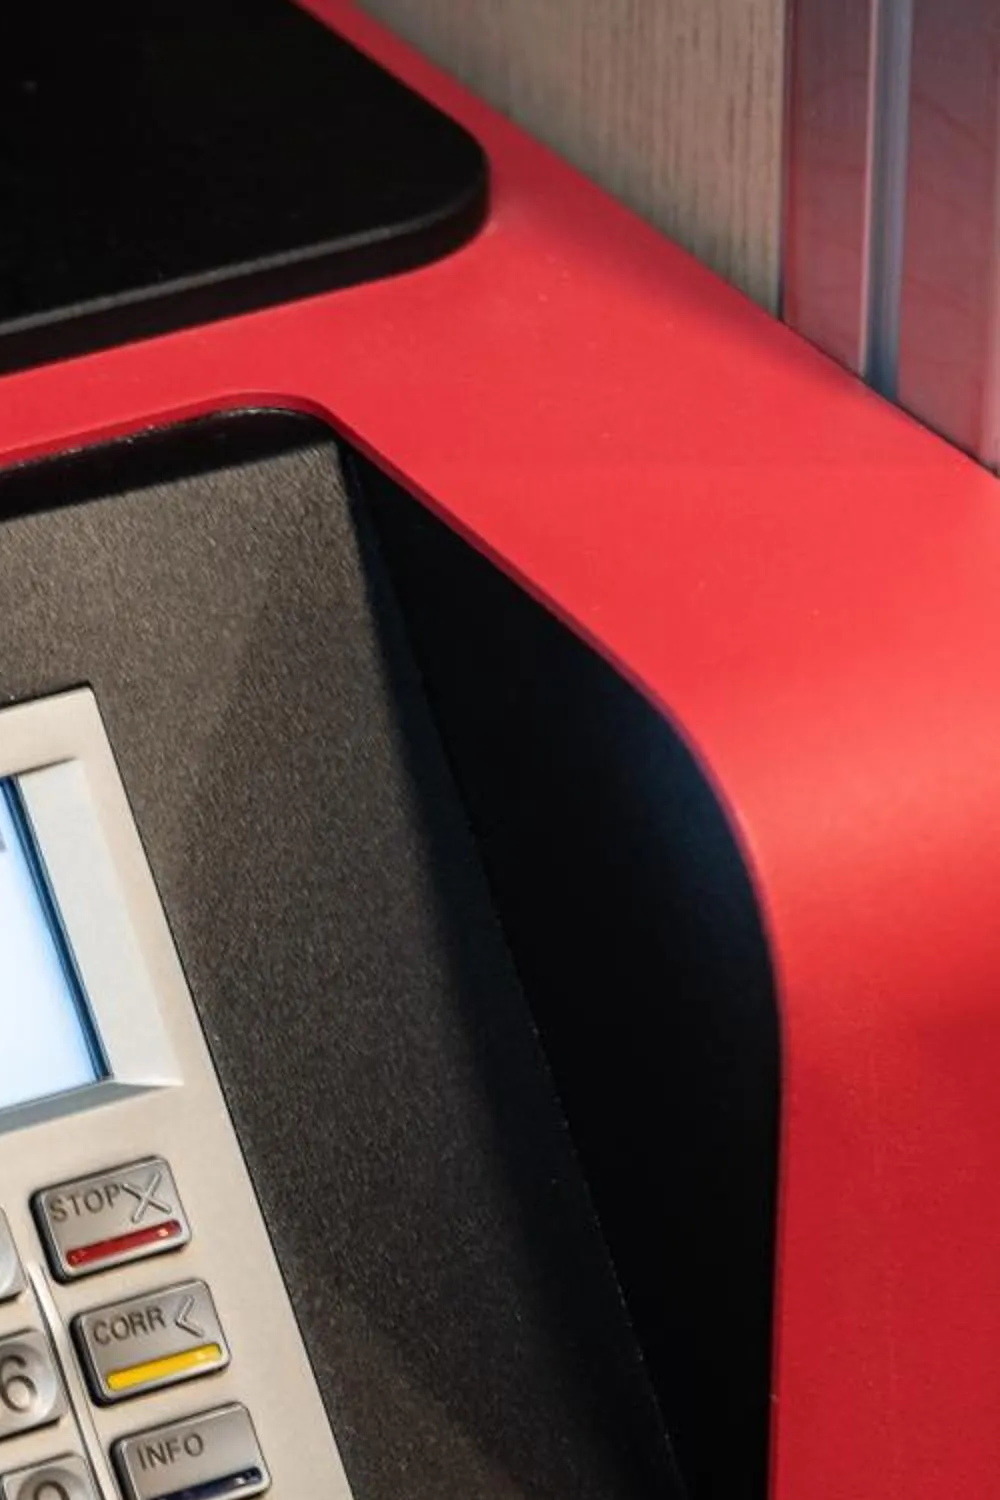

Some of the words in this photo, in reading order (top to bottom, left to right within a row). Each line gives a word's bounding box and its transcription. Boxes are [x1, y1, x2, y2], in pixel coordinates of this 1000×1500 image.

[49, 1182, 124, 1223] STOP
[90, 1306, 167, 1345] CORR
[136, 1432, 205, 1472] INFO
